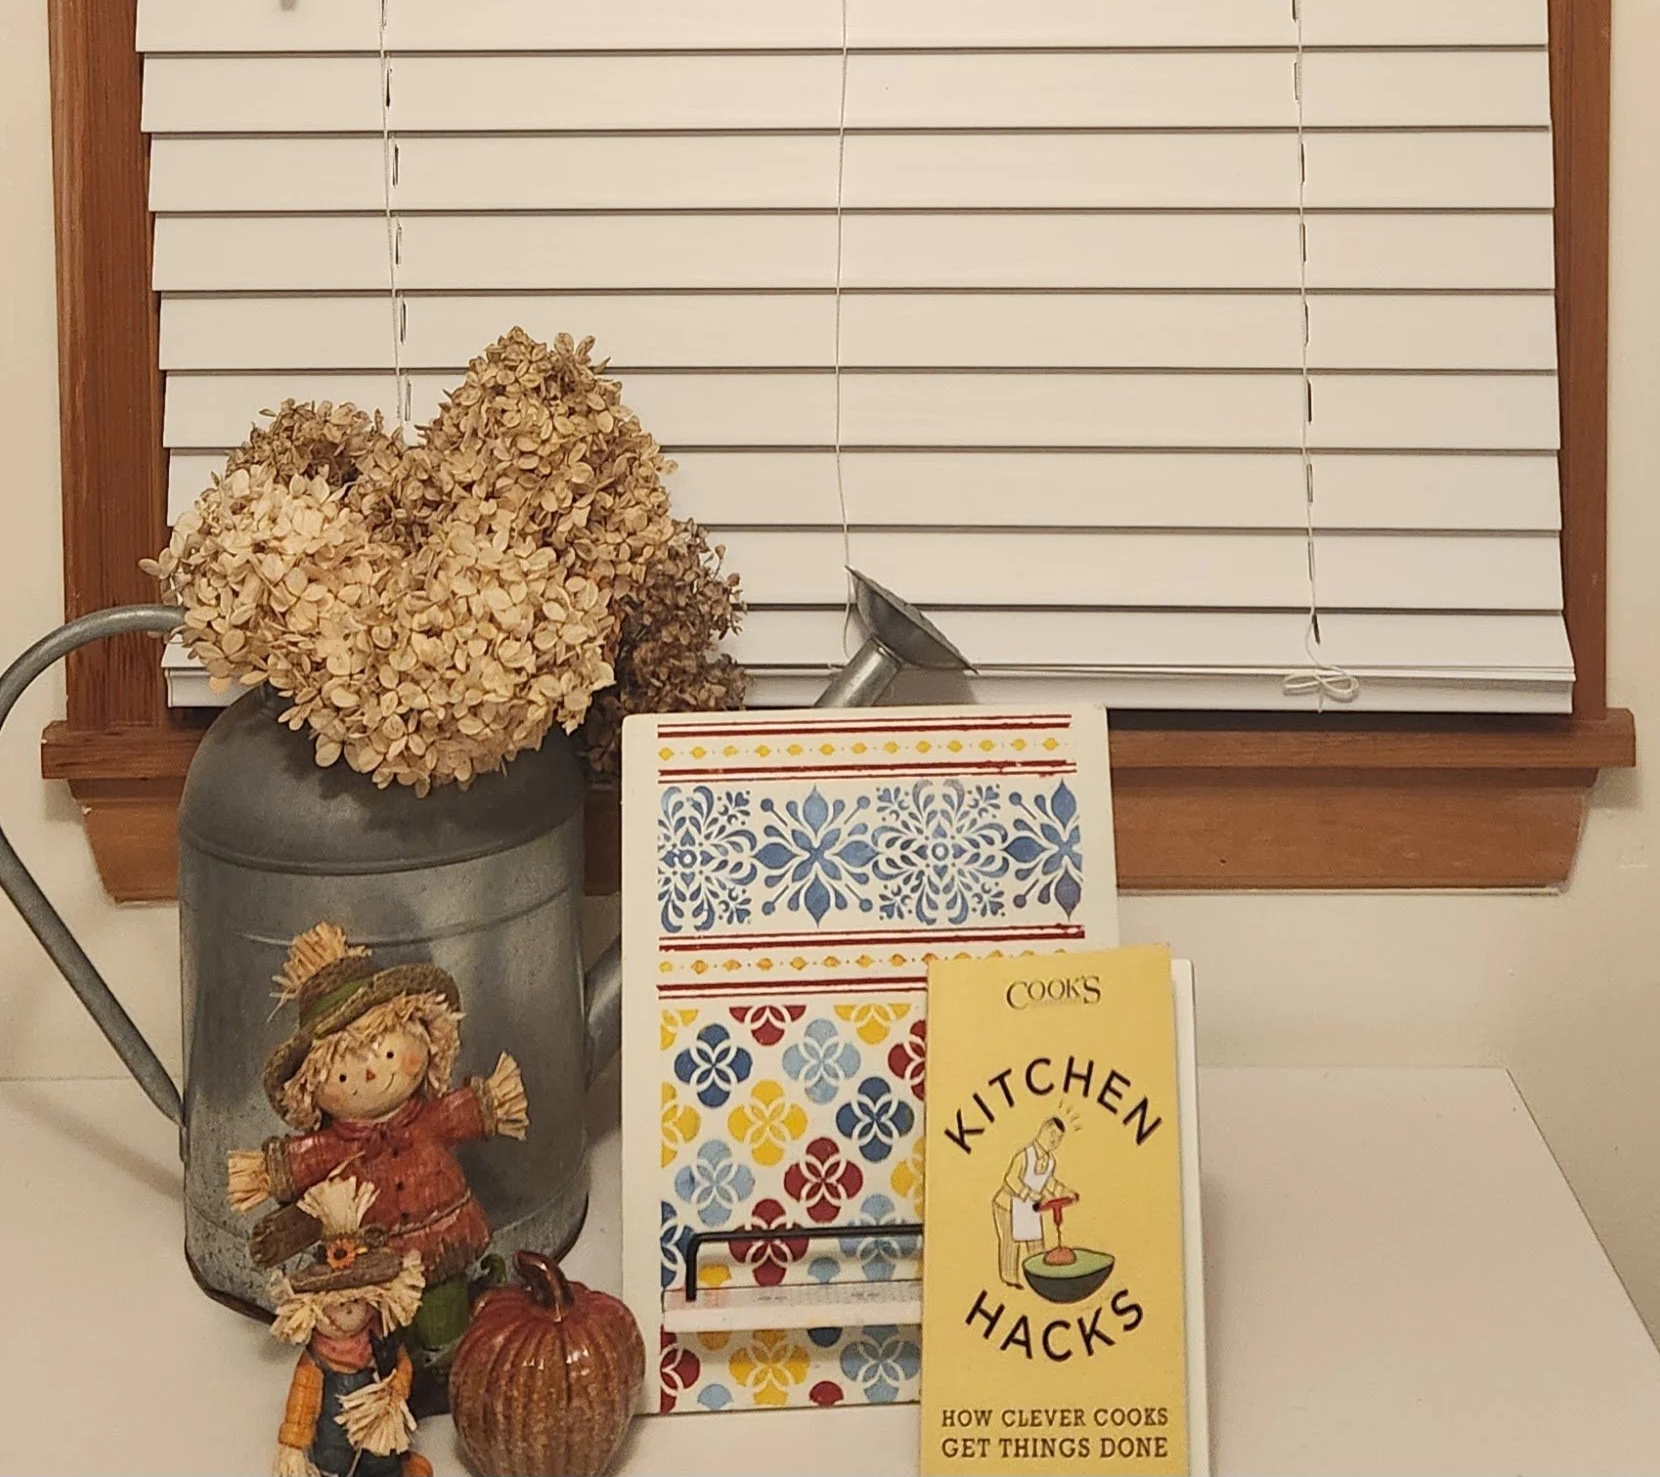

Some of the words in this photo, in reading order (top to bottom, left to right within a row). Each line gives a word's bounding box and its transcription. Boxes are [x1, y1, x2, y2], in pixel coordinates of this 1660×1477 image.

[1005, 975, 1102, 1010] COOK'S
[943, 1055, 1162, 1155] KITCHEN
[964, 1289, 1144, 1363] HACKS
[941, 1409, 994, 1428] HOW
[1001, 1408, 1087, 1428] CLEVER
[1093, 1407, 1170, 1426] COOKS
[941, 1438, 991, 1458] GET
[1000, 1437, 1091, 1458] THINGS
[1099, 1436, 1169, 1458] DONE
